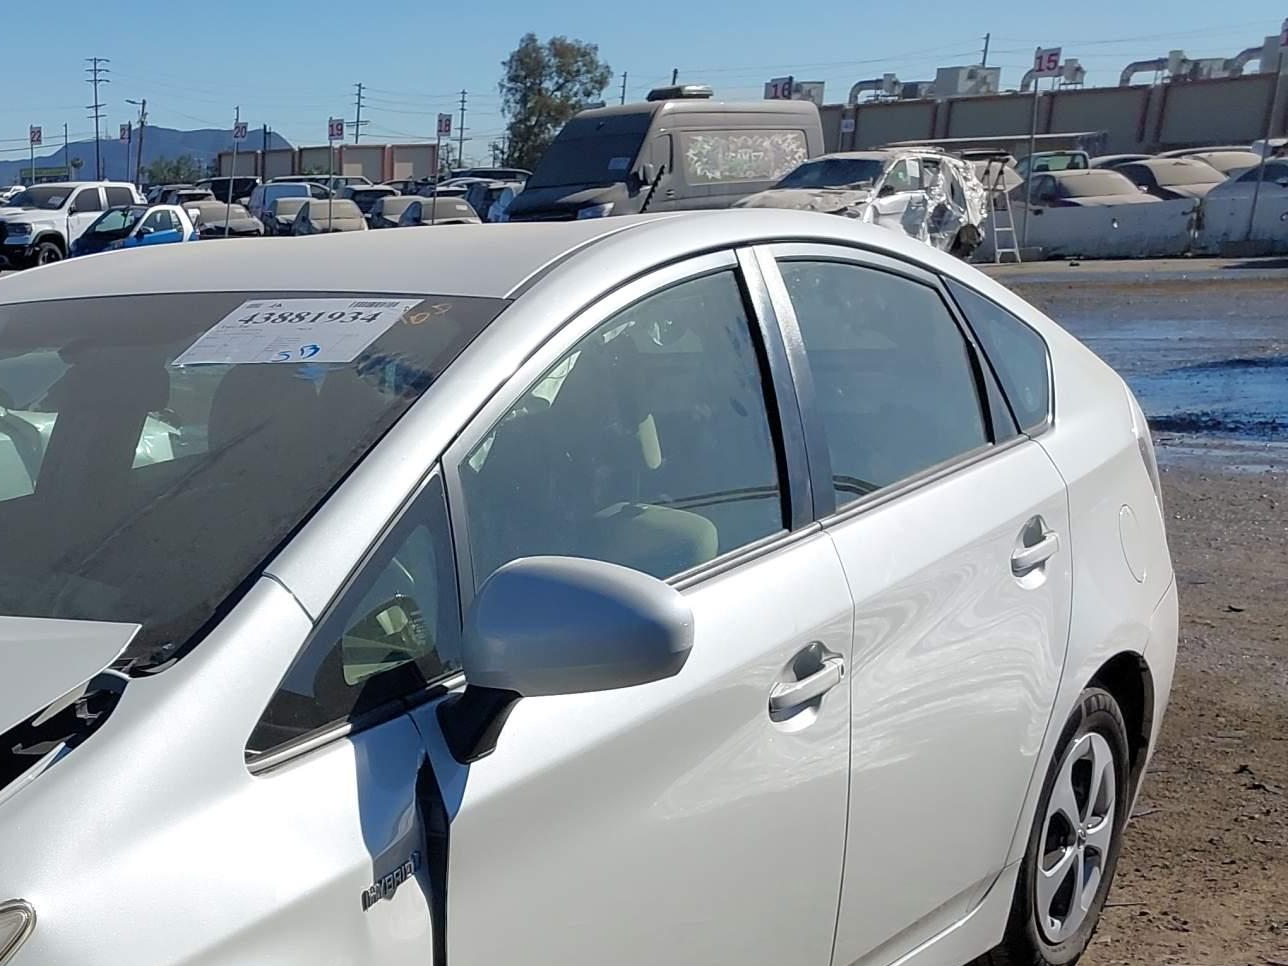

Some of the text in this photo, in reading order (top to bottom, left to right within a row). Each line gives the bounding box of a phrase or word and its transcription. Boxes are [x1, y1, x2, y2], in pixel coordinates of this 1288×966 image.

[1035, 53, 1059, 73] 15
[233, 125, 247, 139] 20
[329, 123, 344, 137] 19
[438, 119, 451, 133] 18
[30, 131, 41, 142] 22
[238, 310, 383, 327] 43881934
